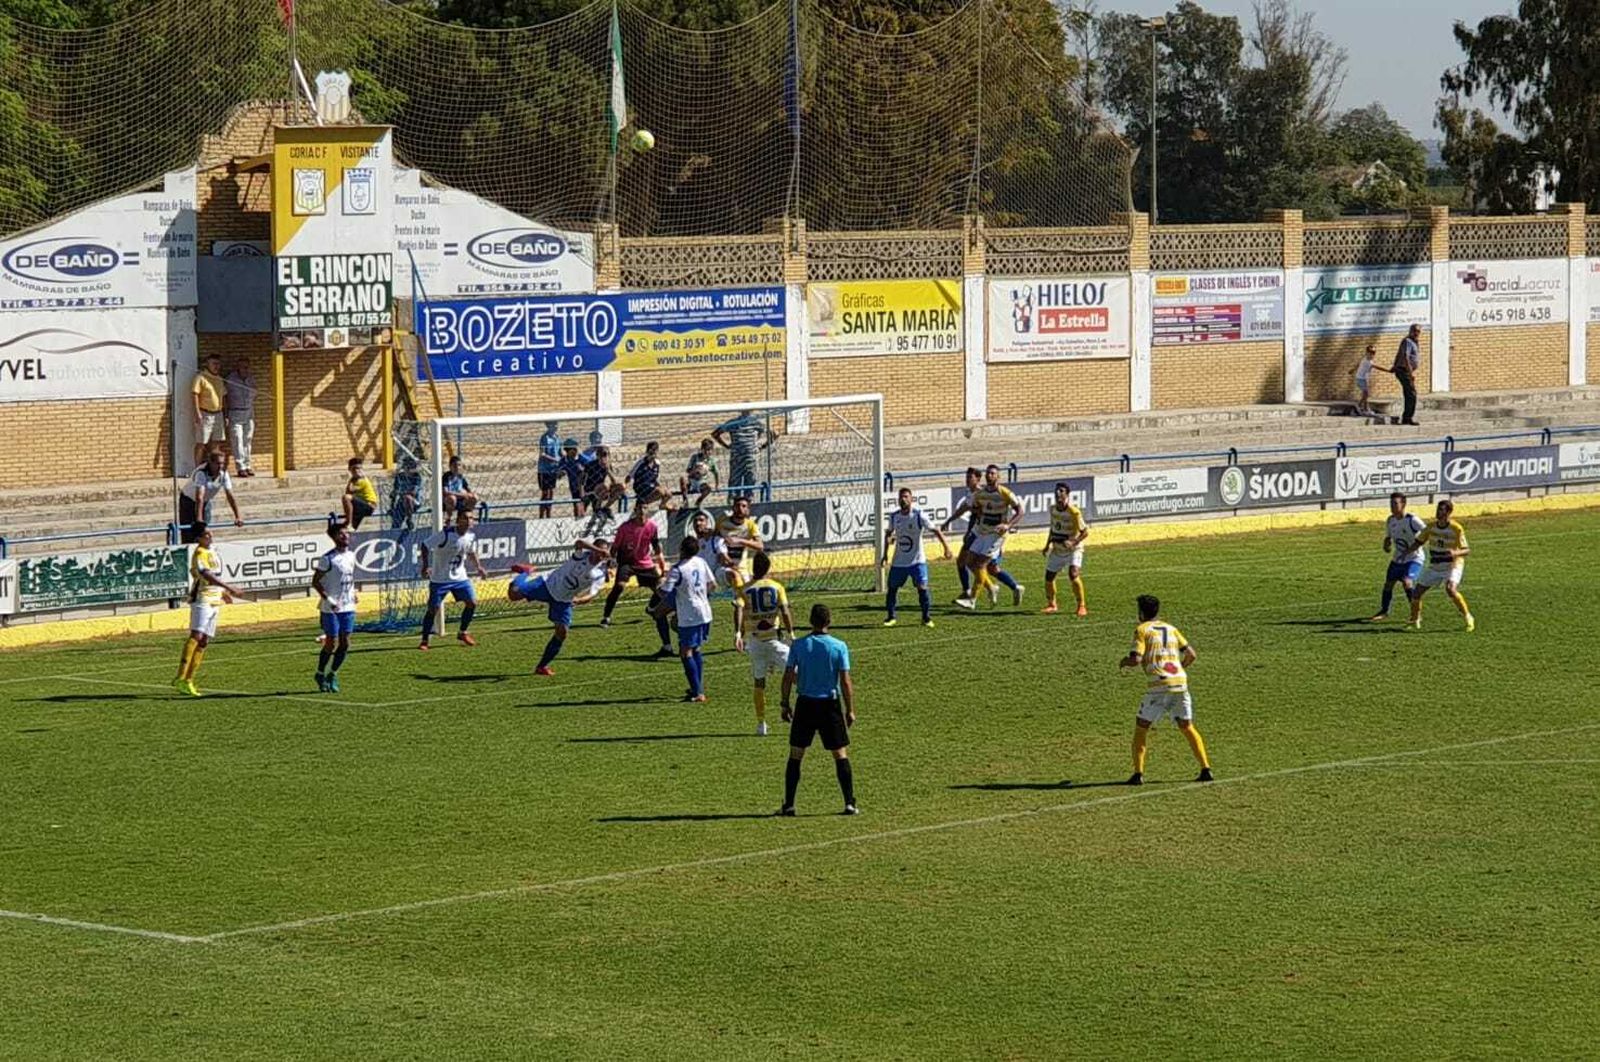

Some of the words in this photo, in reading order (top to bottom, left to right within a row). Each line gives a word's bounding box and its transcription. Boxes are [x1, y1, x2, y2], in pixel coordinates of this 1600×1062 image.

[290, 147, 314, 158] CORIA
[340, 146, 380, 158] VISITANTE
[478, 239, 560, 255] DEBAÑO
[15, 250, 114, 268] DEBAÑO
[278, 257, 304, 286] EL
[310, 255, 392, 284] RINCON
[467, 260, 519, 279] MAMPARAS
[2, 272, 64, 294] MAMPARAS
[65, 284, 80, 293] DE
[1190, 277, 1216, 290] CLASES
[1217, 278, 1227, 289] DE
[1227, 273, 1251, 288] INGLÉS
[1252, 277, 1257, 287] Y
[1258, 275, 1280, 288] CHINO
[284, 284, 386, 315] SERRANO
[628, 295, 678, 313] IMPRESIÓN
[679, 296, 714, 311] DIGITAL
[723, 290, 779, 308] ROTULACIÓN
[842, 292, 885, 309] Gráficas
[1038, 282, 1108, 307] HIELOS
[1333, 290, 1350, 302] LA
[1355, 286, 1427, 301] ESTRELLA
[338, 314, 350, 326] 95
[366, 312, 379, 324] 55
[380, 312, 392, 324] 22
[842, 310, 897, 334] SANTA
[903, 304, 957, 331] MARÍA
[1040, 314, 1056, 329] La
[1058, 313, 1106, 329] Estrella
[1481, 309, 1503, 321] 645
[1507, 308, 1526, 320] 918
[1530, 307, 1551, 320] 438
[423, 301, 617, 354] BOZETO
[653, 340, 669, 351] 600
[731, 335, 746, 346] 954
[772, 333, 782, 343] 02
[897, 336, 909, 350] 95
[911, 335, 929, 349] 477
[933, 335, 944, 349] 10
[946, 334, 957, 348] 91
[461, 352, 583, 374] creativo
[1377, 459, 1421, 470] GRUPO
[1483, 457, 1553, 479] HYUNDAI
[1250, 468, 1322, 500] ŠKODA
[1359, 470, 1438, 486] VERDUGO
[1131, 481, 1178, 493] VERDUGO
[1097, 495, 1205, 515] www.autosverdugo.com
[253, 542, 317, 557] GRUPO
[226, 557, 320, 578] VERDU
[692, 570, 701, 587] 2
[746, 586, 778, 613] 10
[1152, 626, 1168, 648] 7
